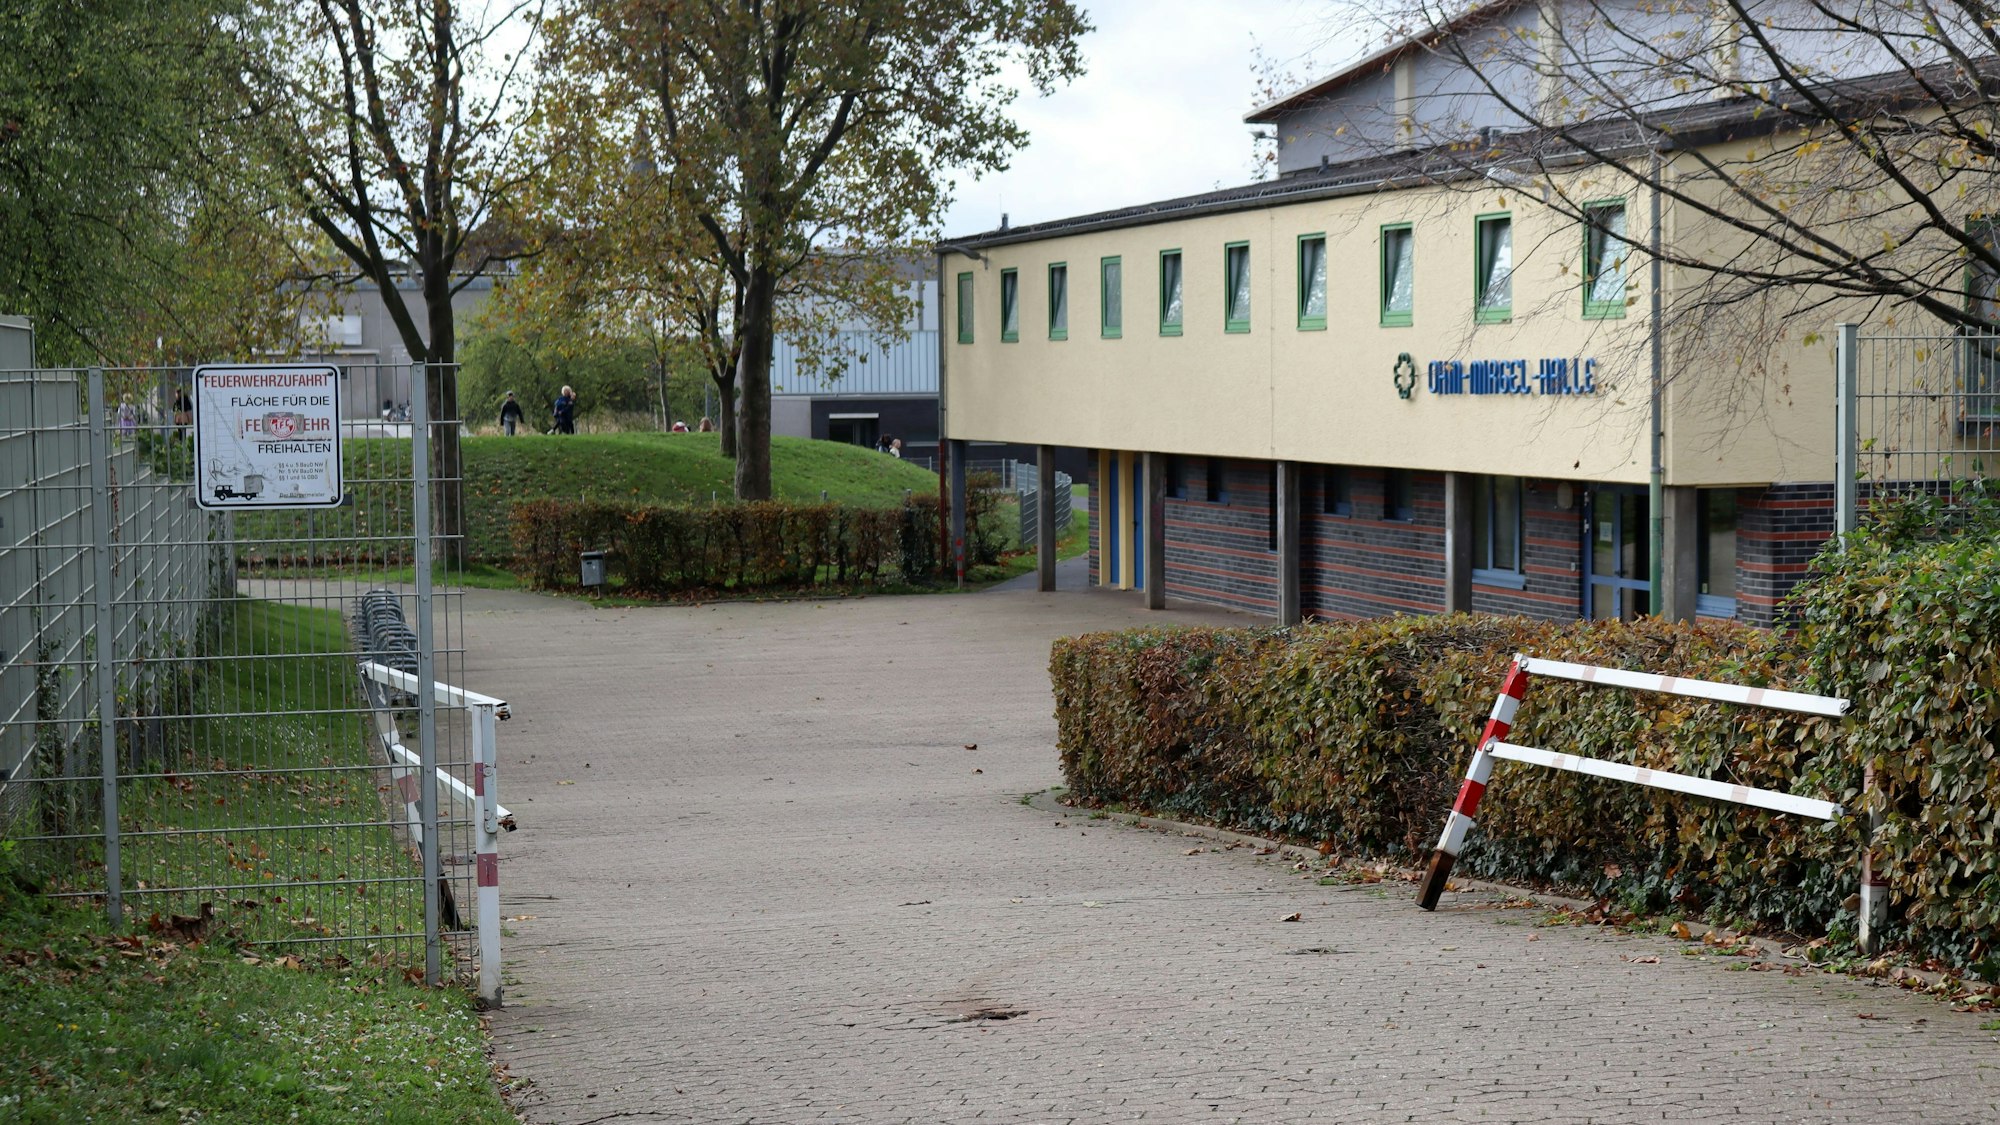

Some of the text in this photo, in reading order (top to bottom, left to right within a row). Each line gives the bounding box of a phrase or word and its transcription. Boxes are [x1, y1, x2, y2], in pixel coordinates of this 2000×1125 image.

[204, 373, 329, 388] FEUERWEHRZUFAHRT
[231, 394, 330, 407] FLÄCHE FÜR DIE
[245, 417, 330, 432] FEEHR
[258, 443, 331, 454] FREIHALTEN
